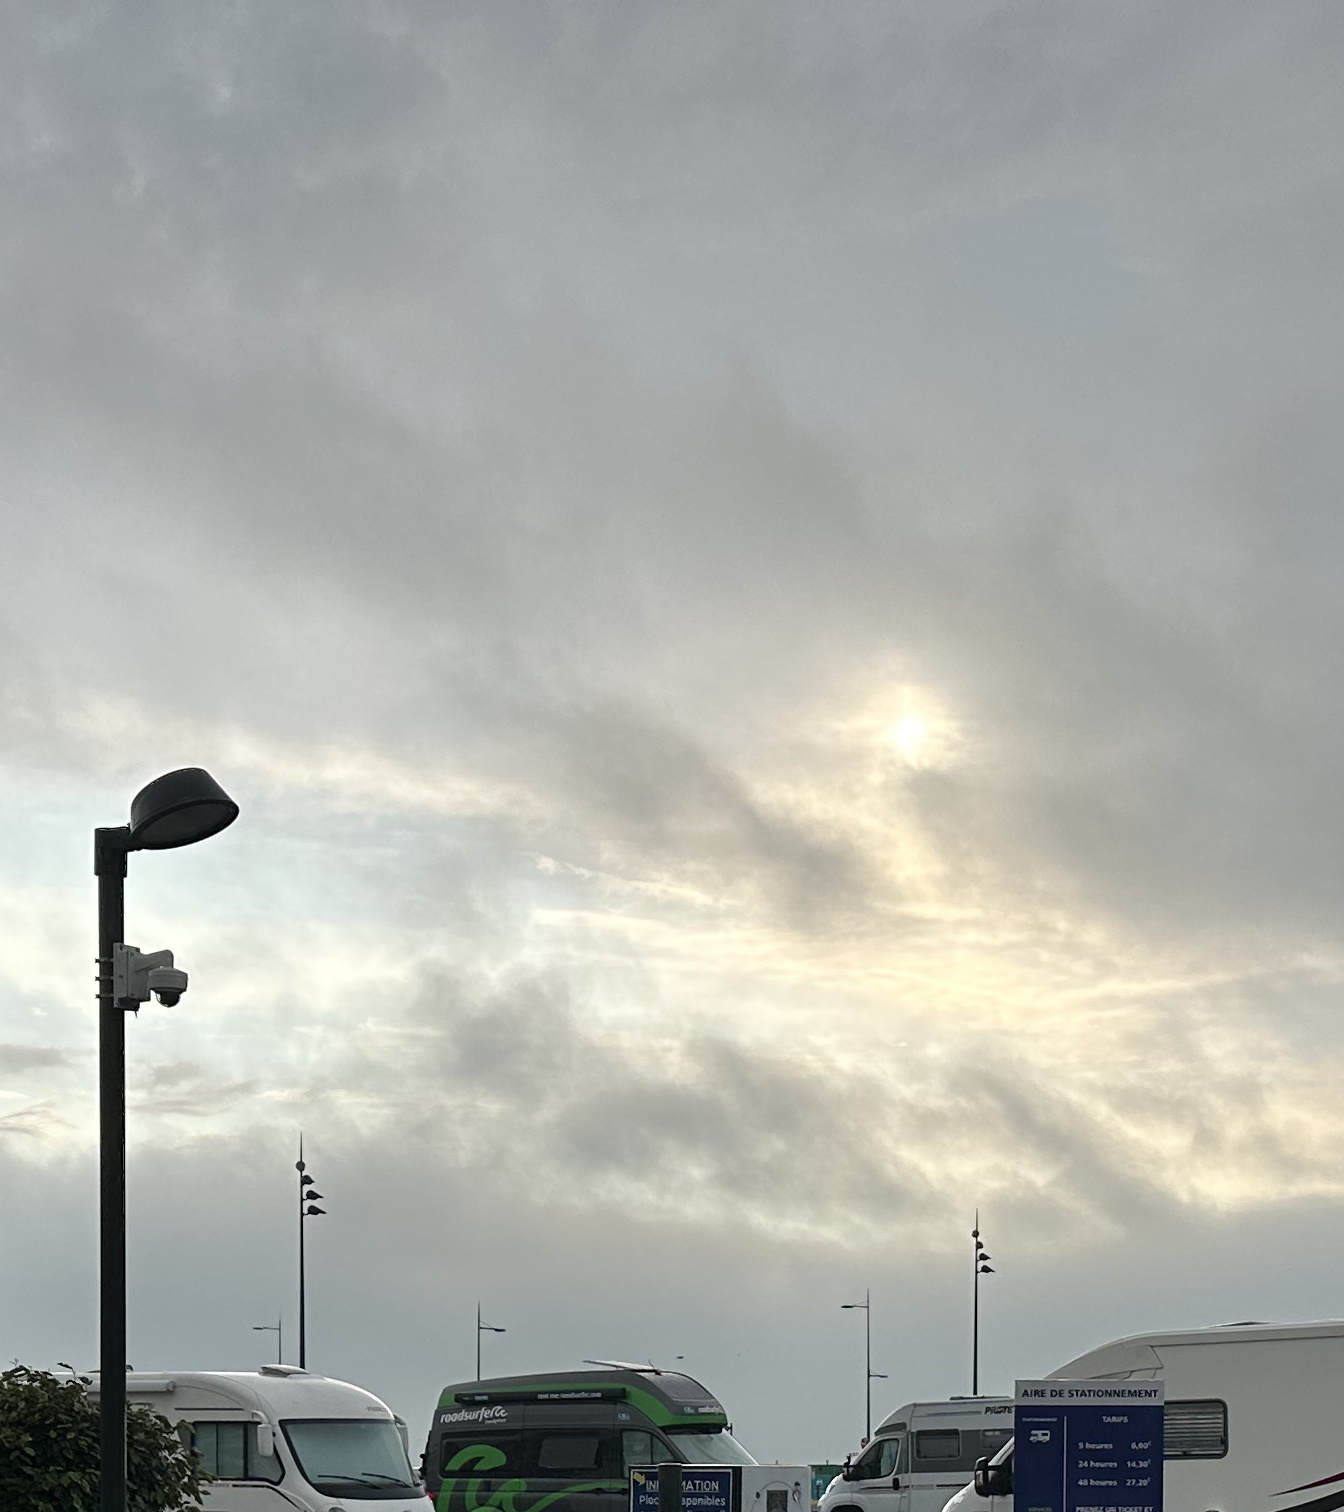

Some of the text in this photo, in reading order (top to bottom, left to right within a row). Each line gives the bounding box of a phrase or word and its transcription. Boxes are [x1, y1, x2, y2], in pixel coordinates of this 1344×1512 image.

[1021, 1388, 1159, 1398] AIRE DE STATIONNEMENT
[1078, 1460, 1088, 1468] 24
